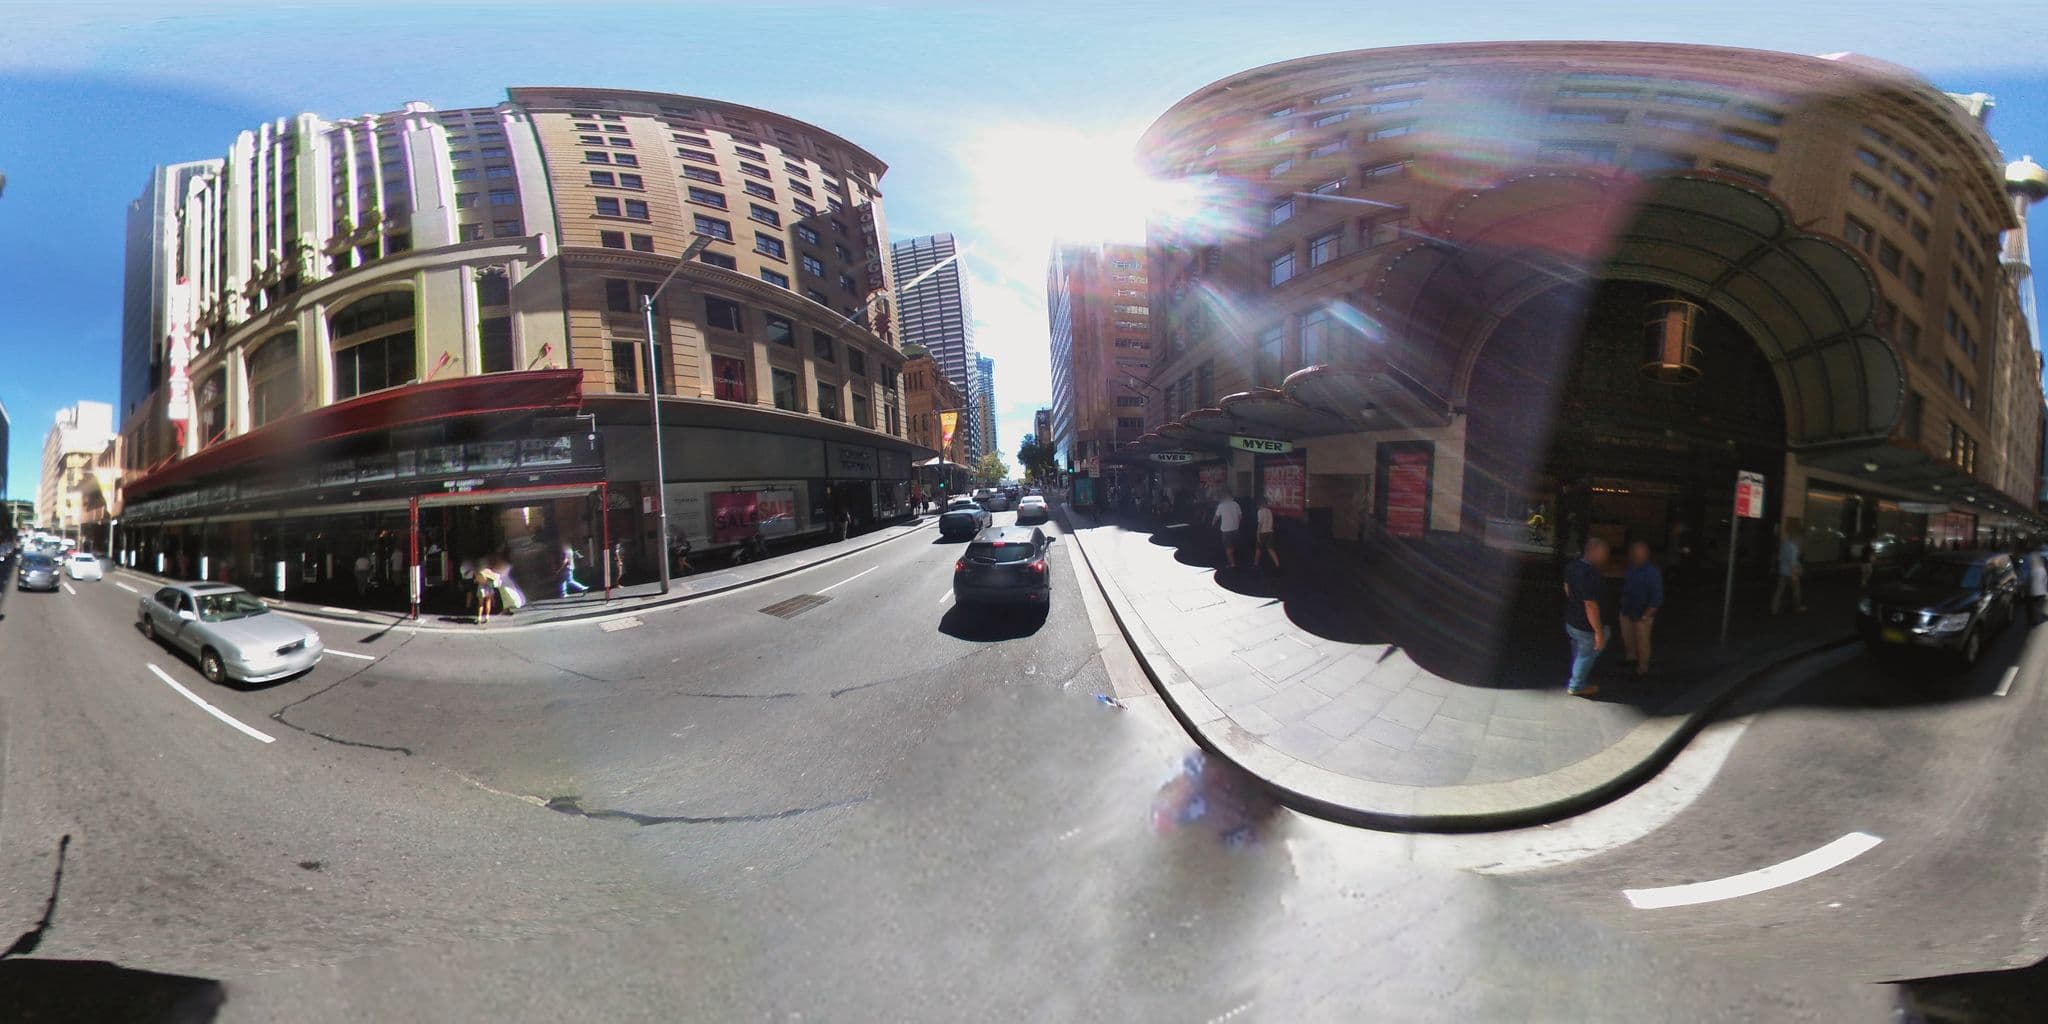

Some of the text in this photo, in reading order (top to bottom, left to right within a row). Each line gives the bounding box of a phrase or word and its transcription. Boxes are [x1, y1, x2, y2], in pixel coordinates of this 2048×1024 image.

[857, 202, 882, 288] GOWINGS
[1242, 439, 1283, 451] MYER
[1265, 487, 1302, 505] SALE
[759, 500, 793, 519] SALE
[716, 509, 758, 530] SALE
